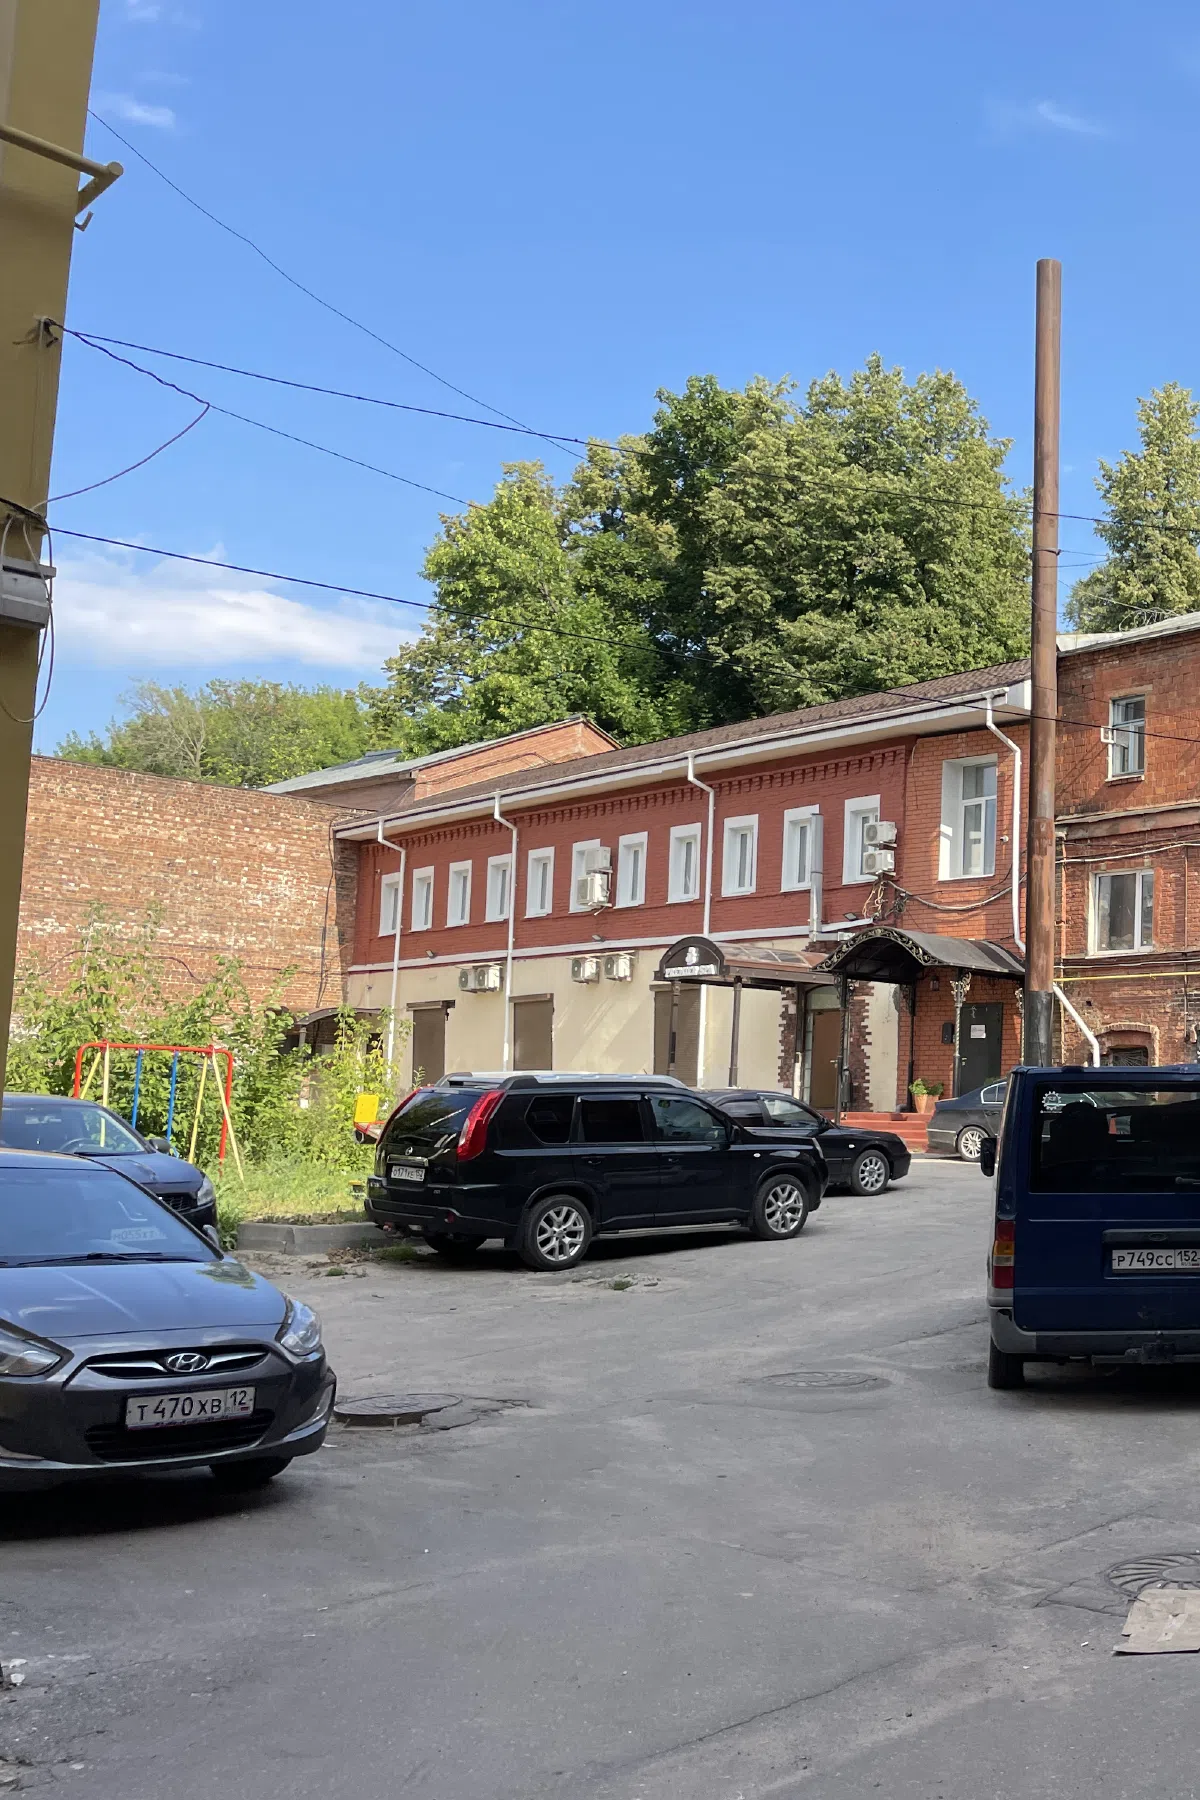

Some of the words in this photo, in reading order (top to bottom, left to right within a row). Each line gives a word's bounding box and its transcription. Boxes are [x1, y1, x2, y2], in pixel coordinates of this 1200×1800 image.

[1117, 1251, 1174, 1267] Р749СС
[1176, 1250, 1198, 1262] 152
[137, 1396, 222, 1421] Т470ХВ
[229, 1390, 247, 1407] 12
